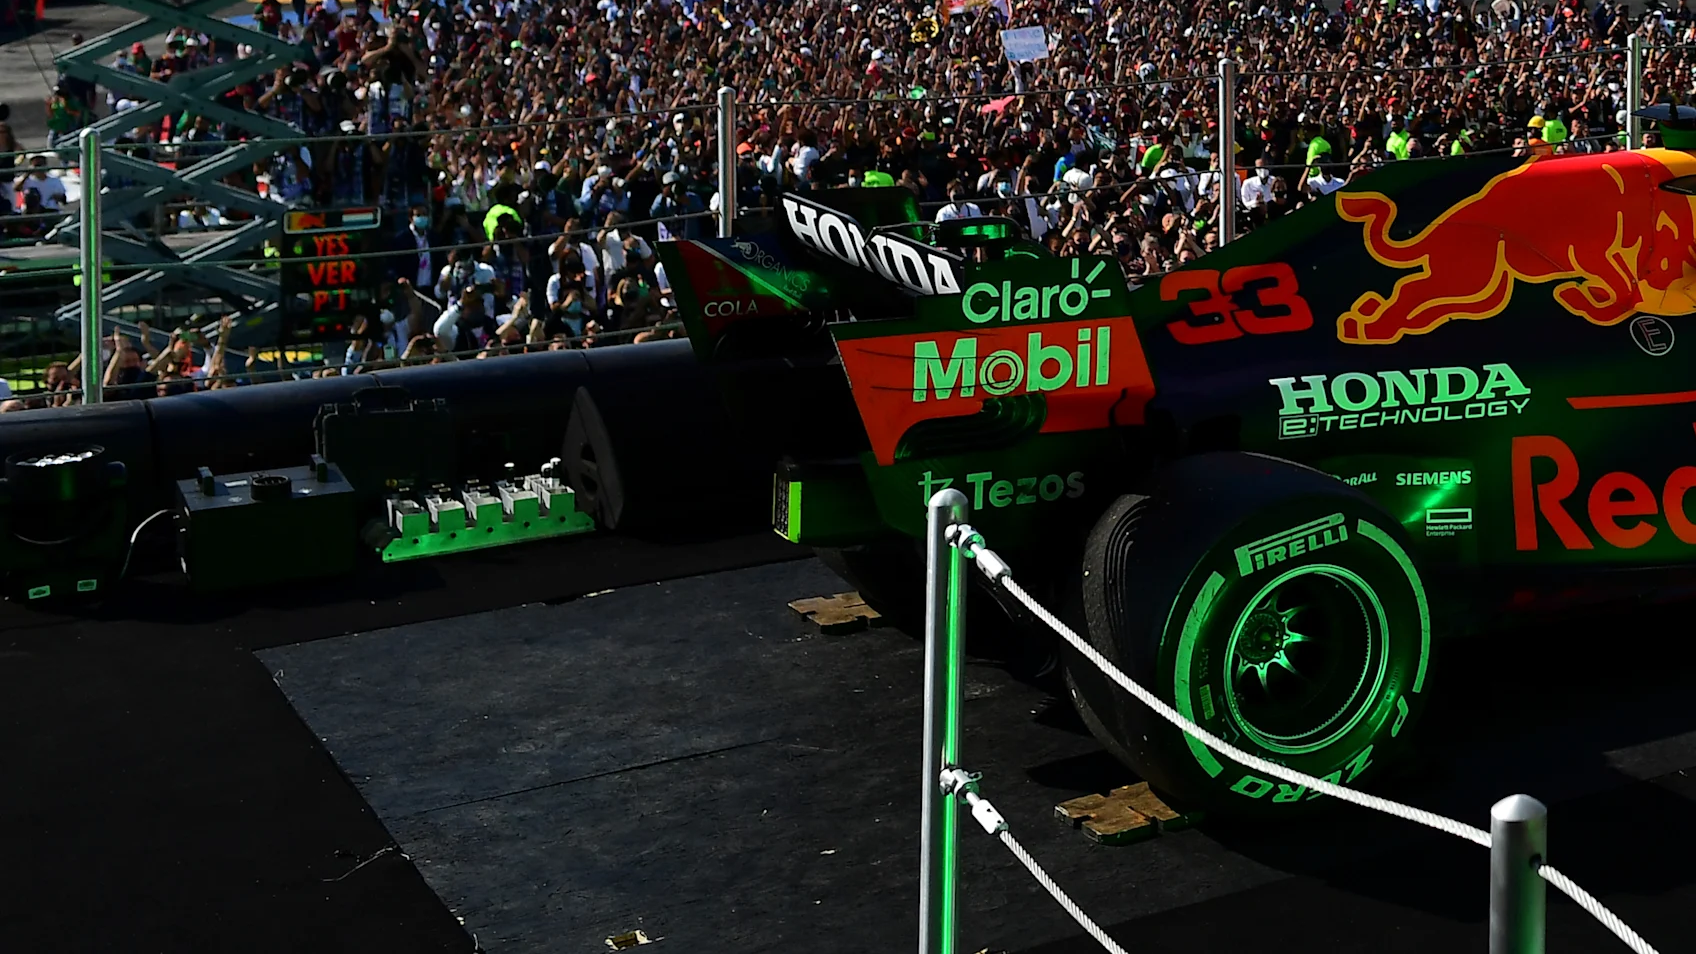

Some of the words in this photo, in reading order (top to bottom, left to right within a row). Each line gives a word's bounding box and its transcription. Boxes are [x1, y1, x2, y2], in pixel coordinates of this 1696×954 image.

[312, 233, 349, 256] YES
[782, 198, 961, 295] HONDA
[307, 259, 356, 285] VER
[704, 299, 759, 317] COLA
[1160, 261, 1314, 345] 33
[912, 326, 1110, 403] Mobil
[1269, 363, 1531, 415] HONDA
[966, 471, 1085, 511] Tezos
[1396, 470, 1471, 486] SIEMENS
[1234, 512, 1349, 577] PIRELLI
